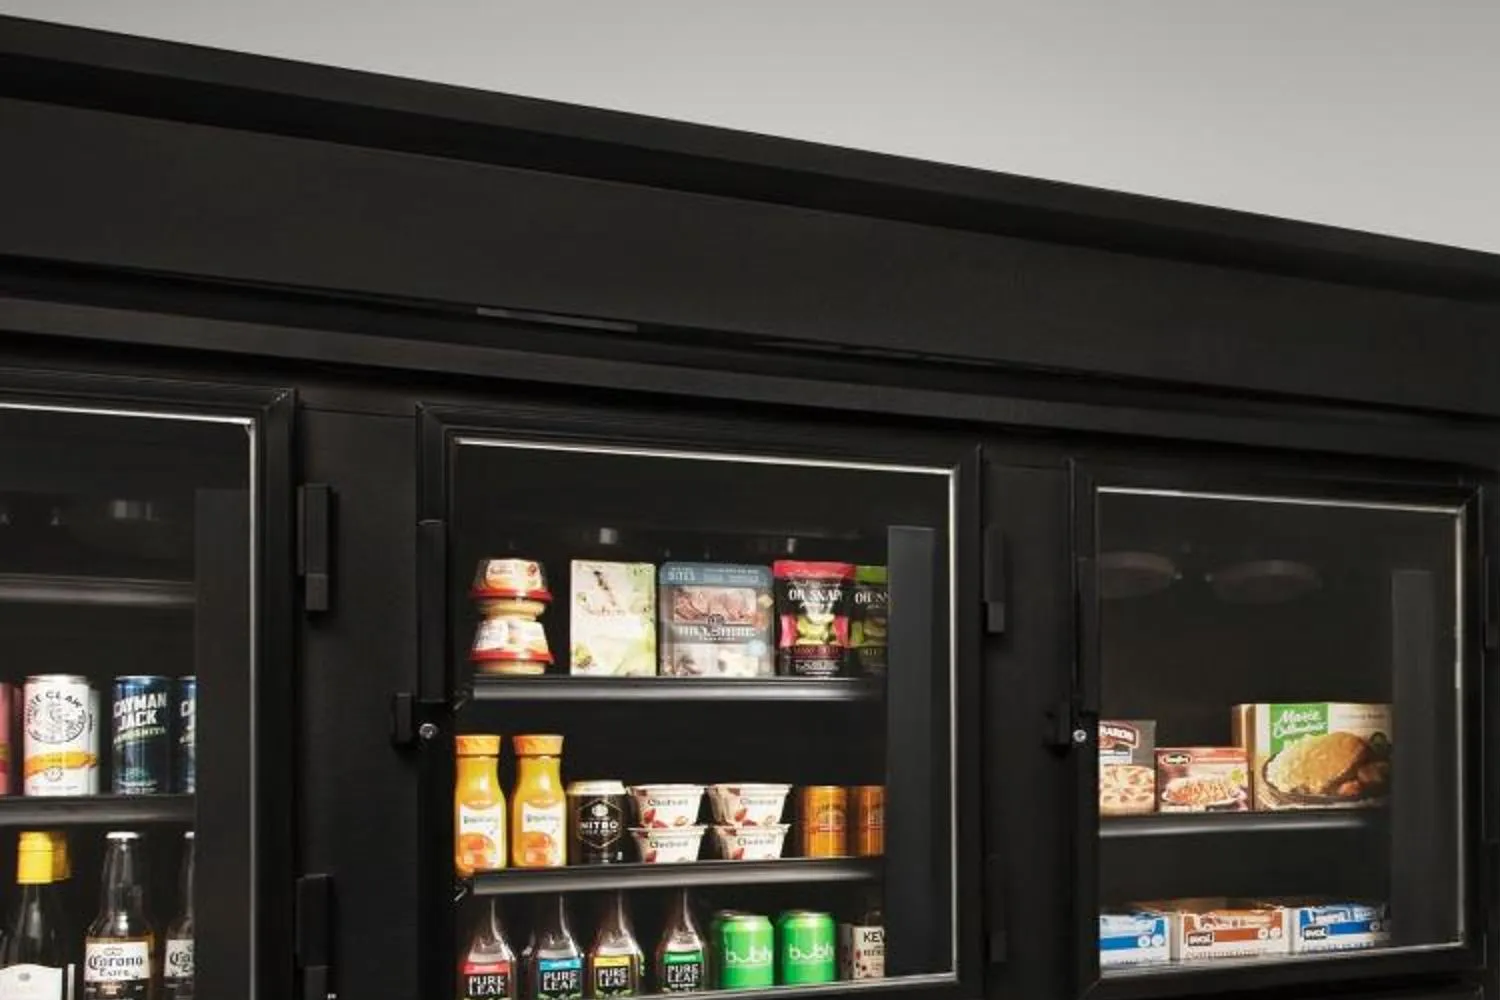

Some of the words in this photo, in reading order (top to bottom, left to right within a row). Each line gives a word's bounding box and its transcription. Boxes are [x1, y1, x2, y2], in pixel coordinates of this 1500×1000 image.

[113, 692, 168, 718] CAYMAN
[119, 710, 157, 731] JACK
[581, 820, 619, 830] NITRO
[863, 931, 885, 943] KEV
[88, 955, 143, 970] Corona
[599, 967, 627, 977] PURE
[667, 963, 699, 974] PURE
[469, 975, 505, 986] PURE
[543, 971, 577, 981] PURE
[599, 976, 627, 987] LEAF
[667, 973, 699, 983] LEAF
[469, 985, 505, 996] LEAF
[543, 980, 577, 991] LEAF
